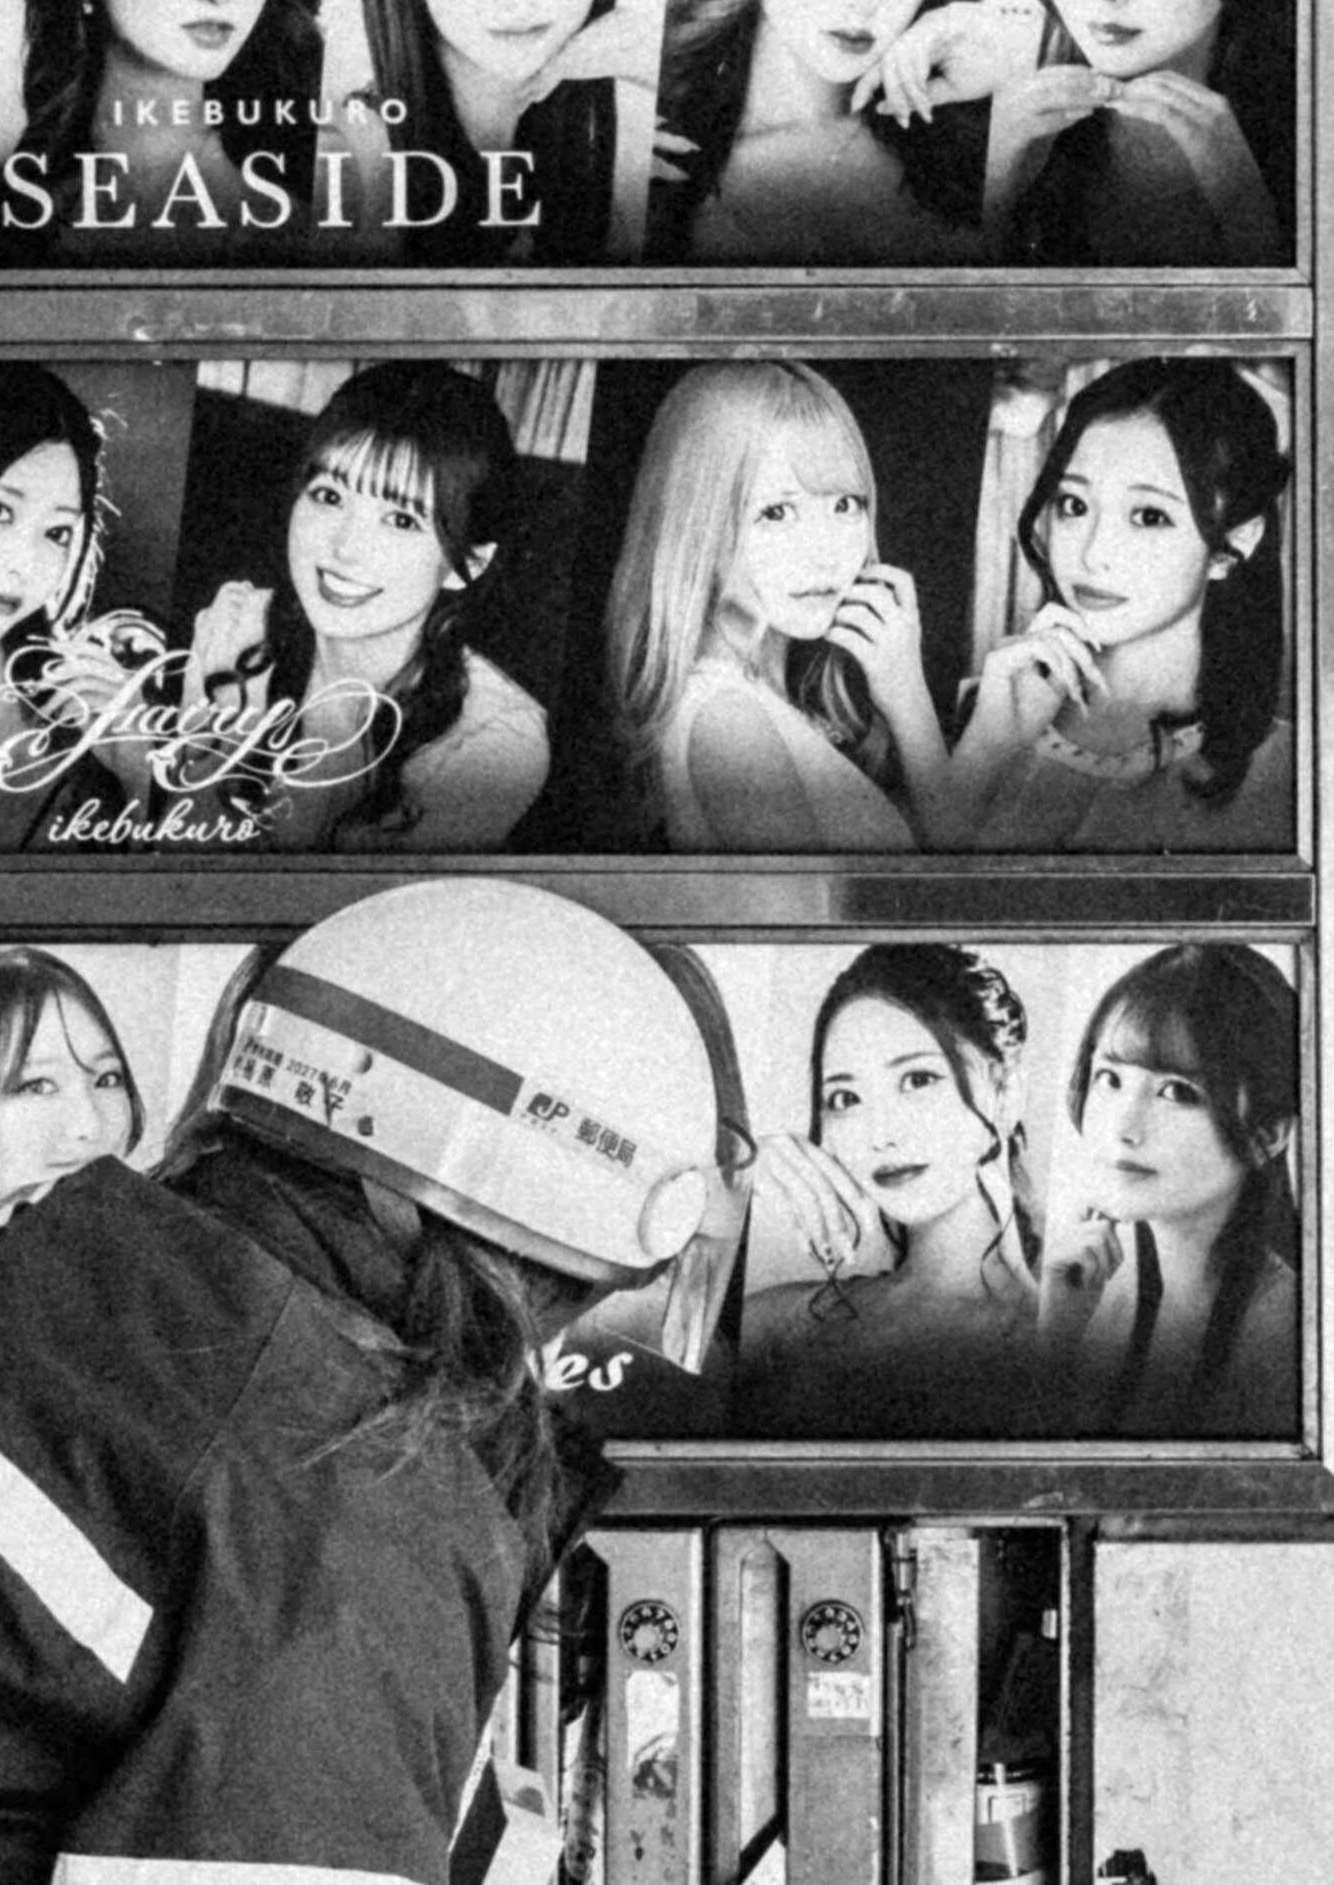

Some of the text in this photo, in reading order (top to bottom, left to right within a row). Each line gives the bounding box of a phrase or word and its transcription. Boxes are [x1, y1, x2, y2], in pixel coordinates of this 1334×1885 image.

[115, 98, 409, 126] IKEBUKURO
[1, 150, 542, 231] SEASIDE
[48, 798, 261, 844] ikebukuro
